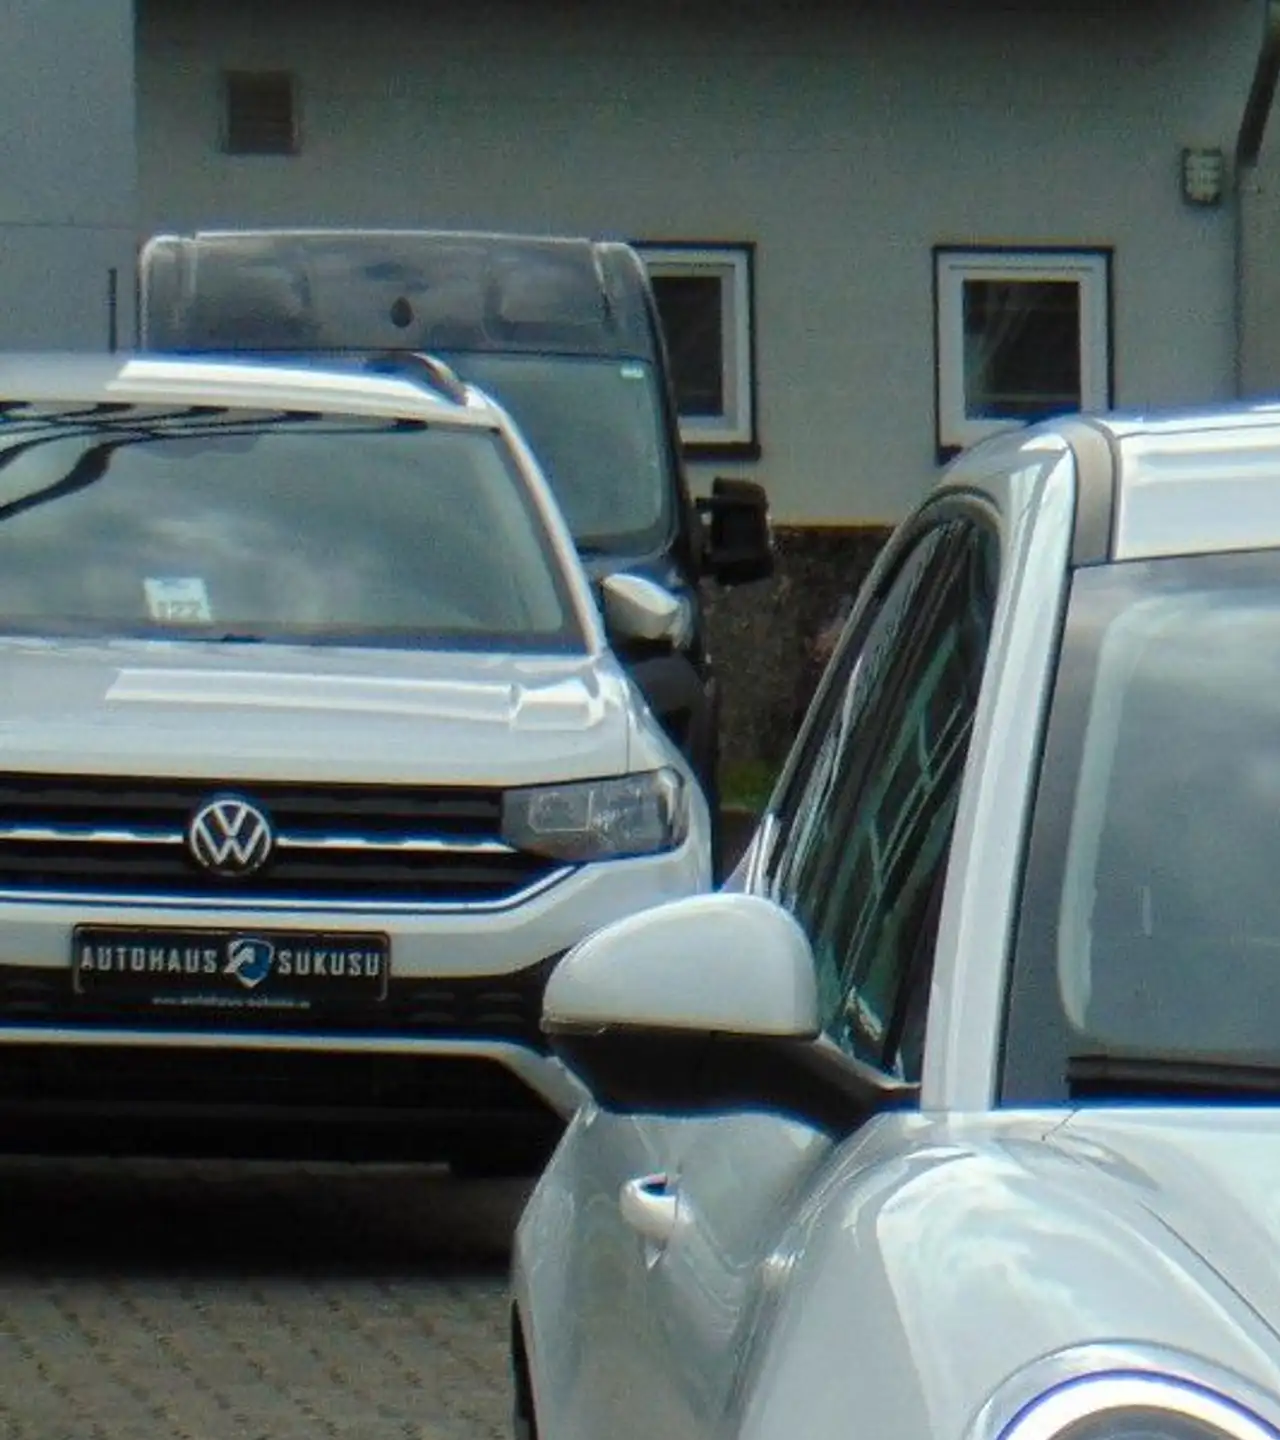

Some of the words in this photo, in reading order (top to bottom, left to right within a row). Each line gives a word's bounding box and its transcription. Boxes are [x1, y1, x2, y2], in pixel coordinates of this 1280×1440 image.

[194, 802, 267, 868] VW
[81, 946, 217, 972] AUTOHAUS
[278, 952, 380, 975] SUKUSU
